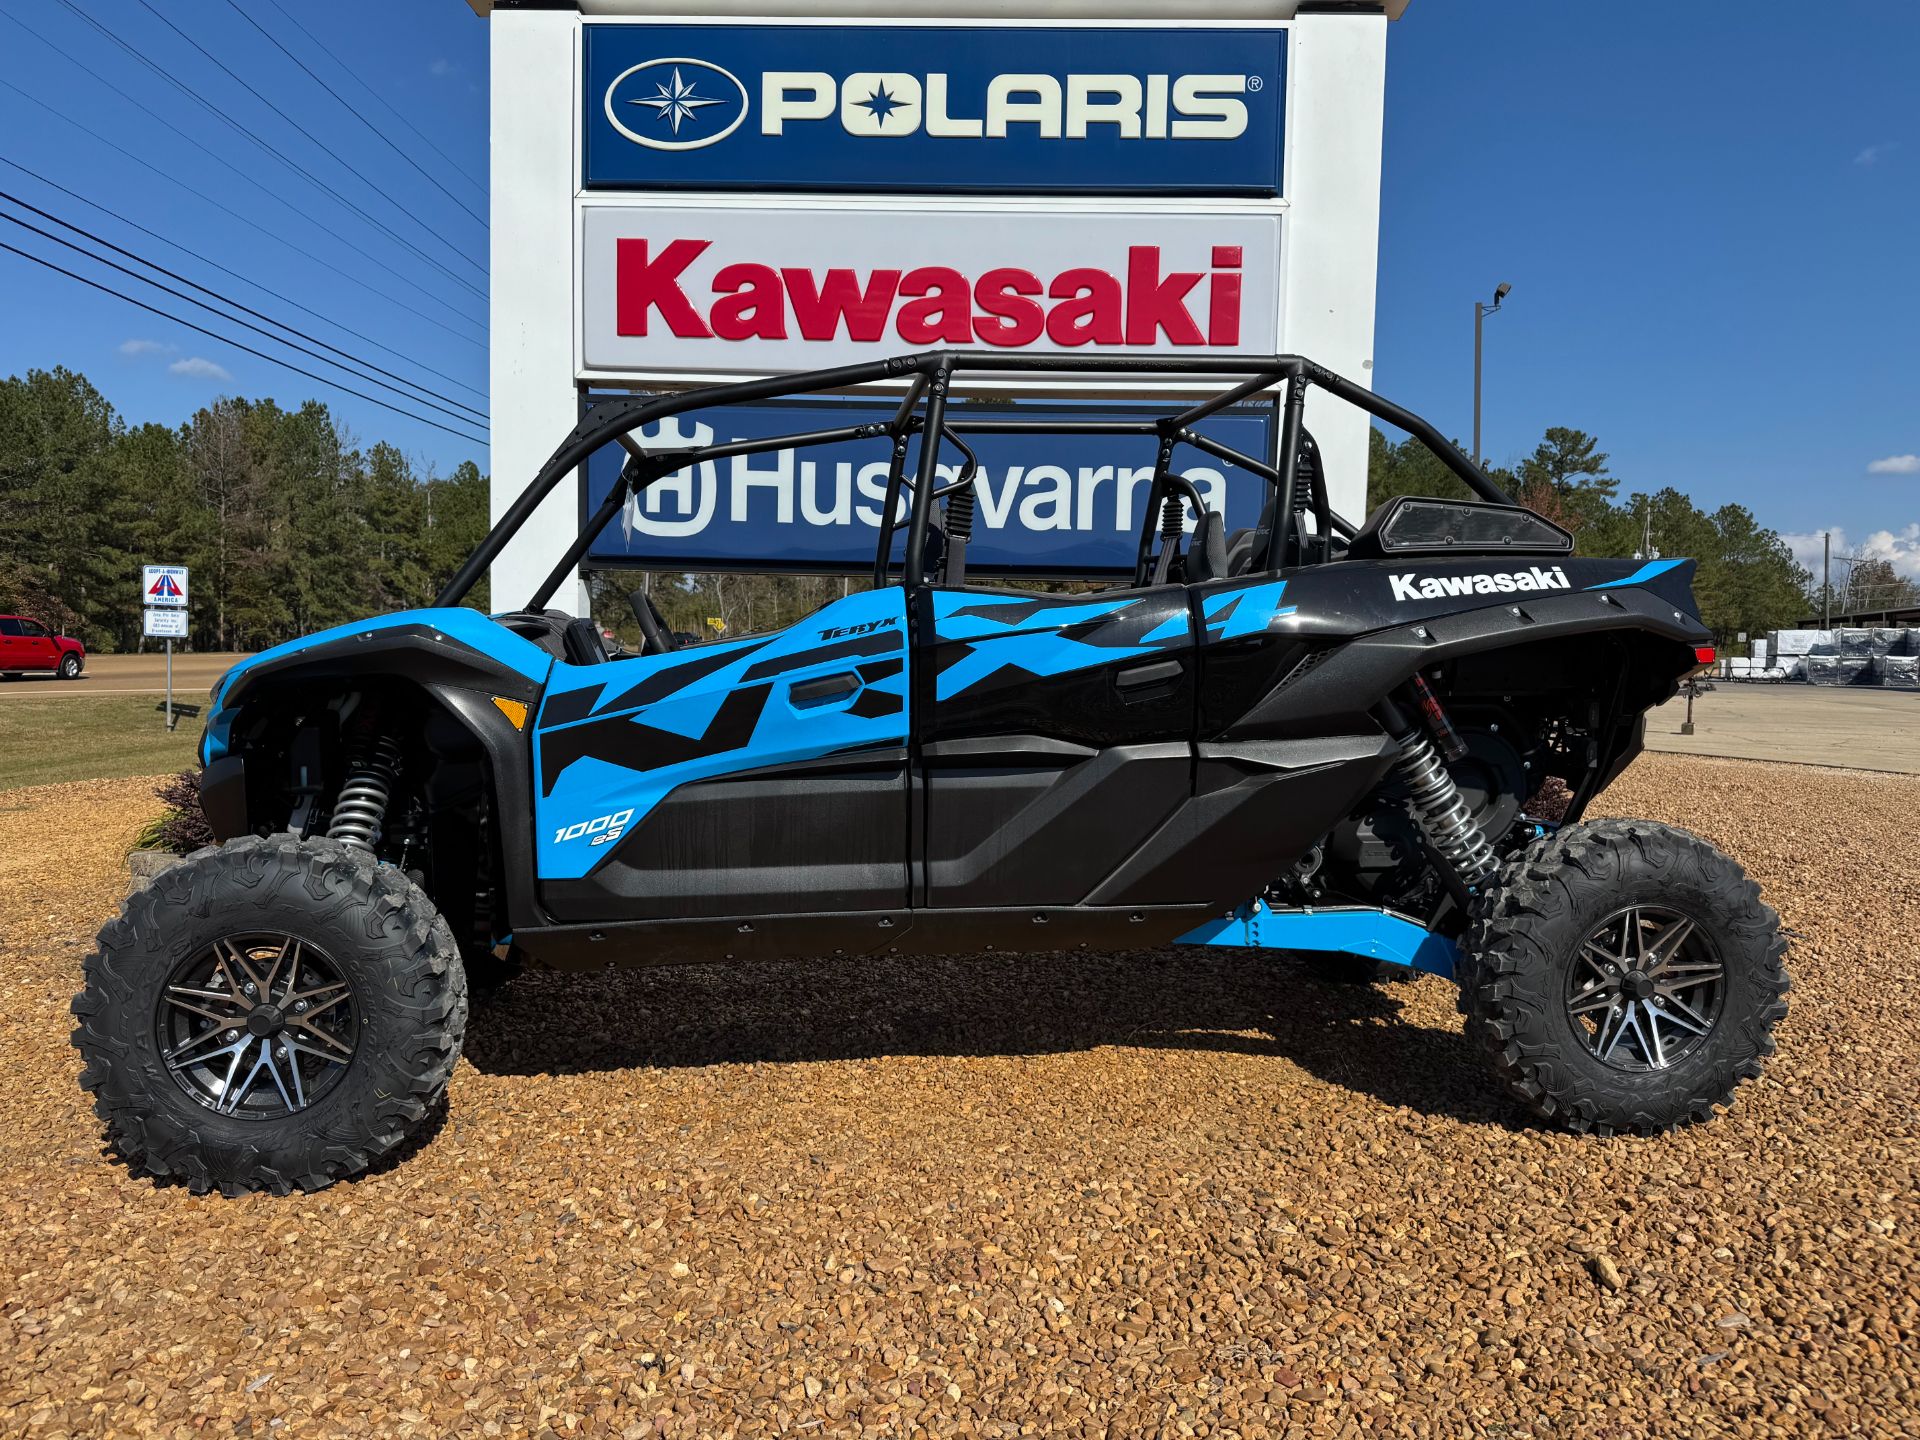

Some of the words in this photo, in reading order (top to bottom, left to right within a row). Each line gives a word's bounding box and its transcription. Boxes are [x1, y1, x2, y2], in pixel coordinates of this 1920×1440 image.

[762, 71, 1249, 140] POLARIS
[616, 237, 1244, 347] Kawasaki
[1388, 566, 1571, 601] Kawasaki
[553, 808, 635, 844] 1000
